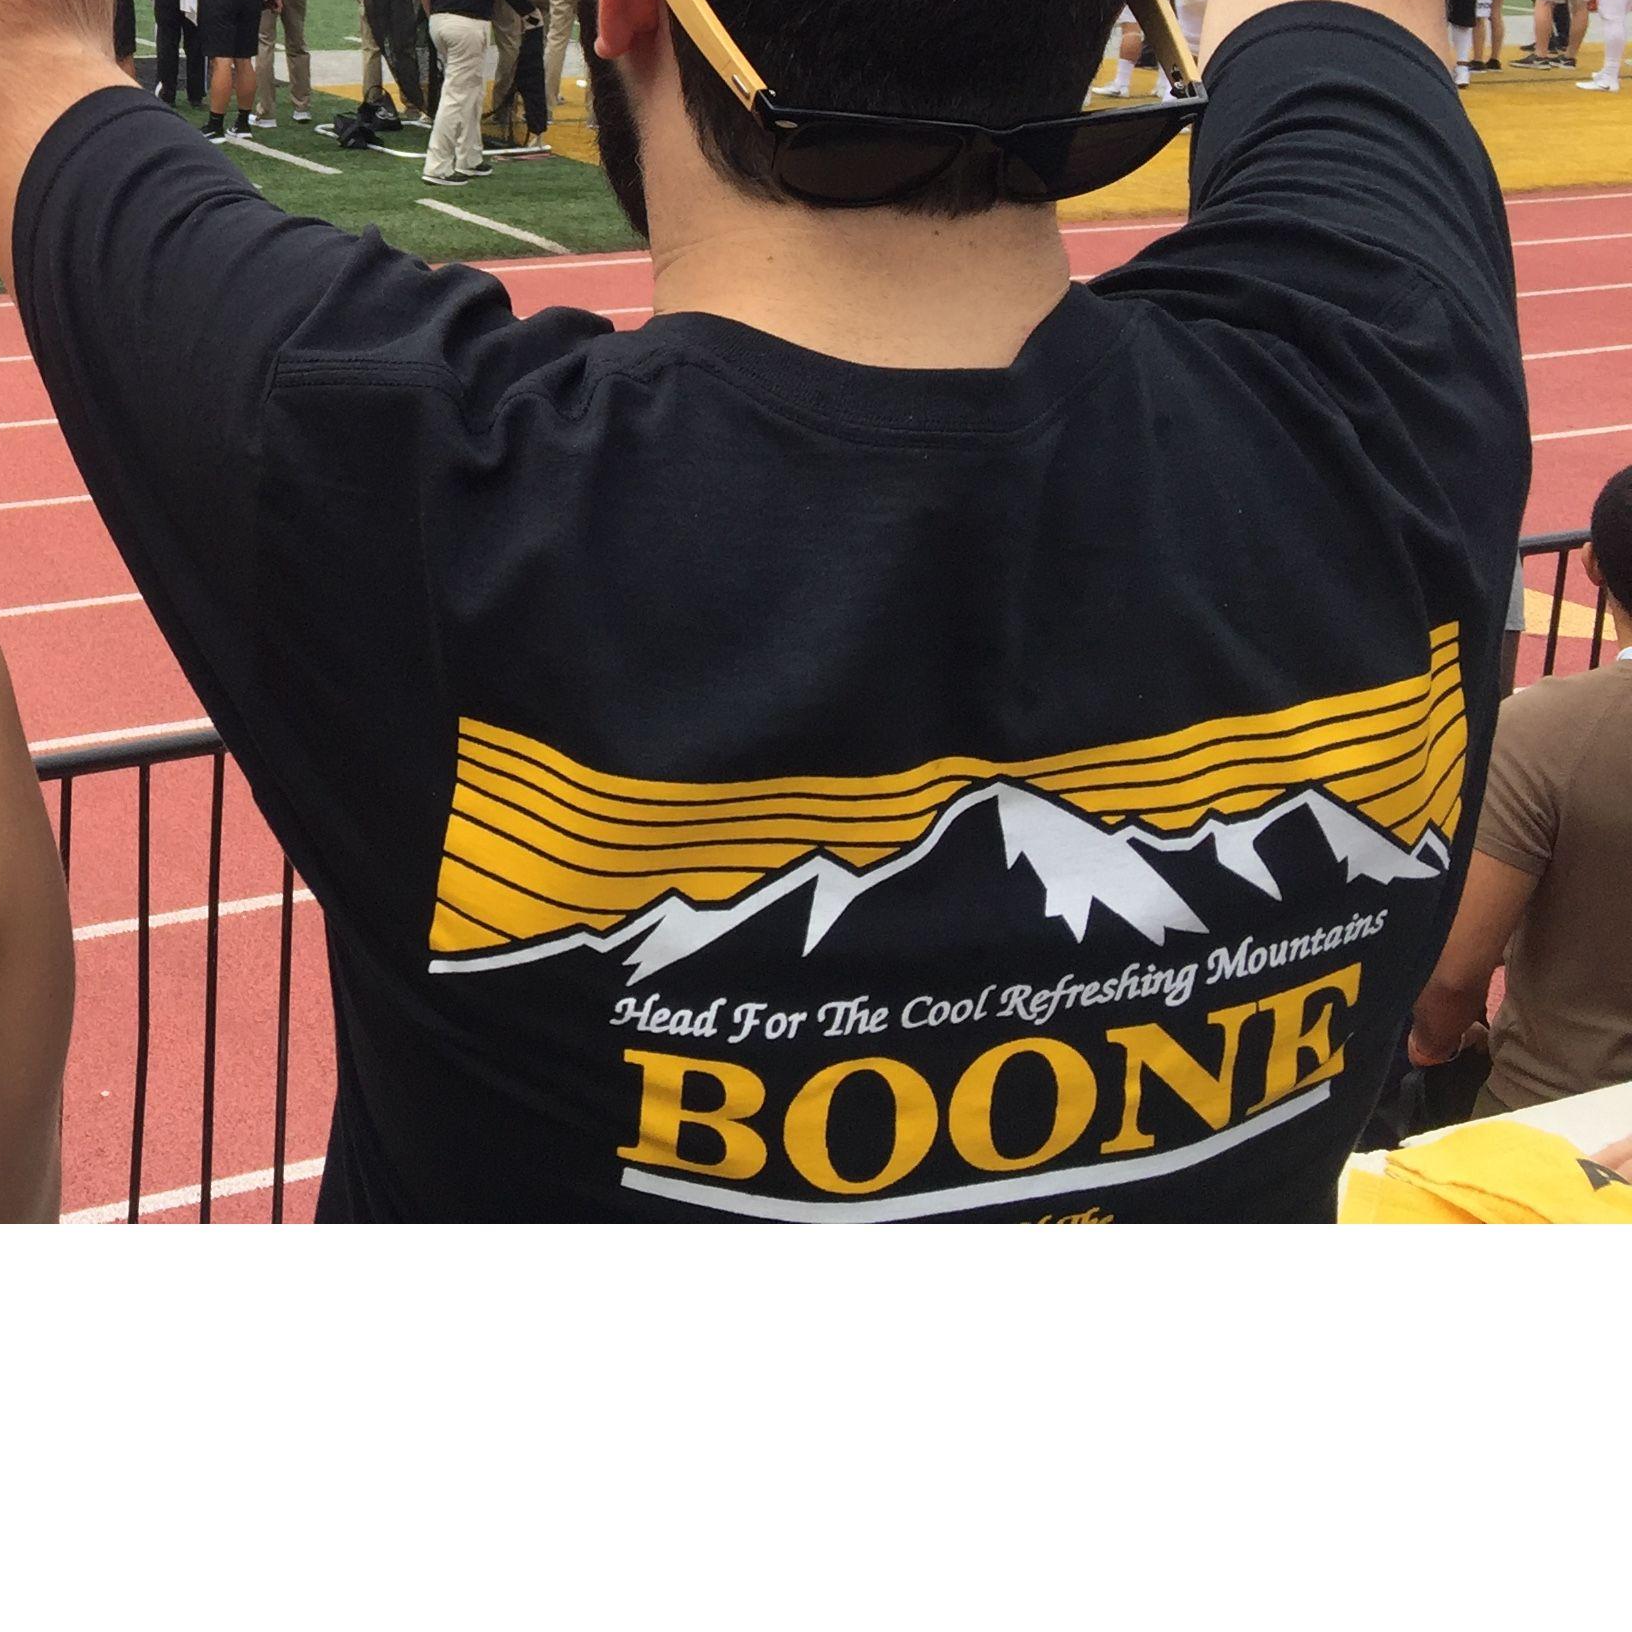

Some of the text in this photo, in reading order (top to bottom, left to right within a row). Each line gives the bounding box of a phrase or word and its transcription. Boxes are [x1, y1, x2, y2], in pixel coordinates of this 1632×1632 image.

[609, 909, 1389, 1044] Head For The Cool Refreshing Mountains
[616, 962, 1362, 1195] BOONE
